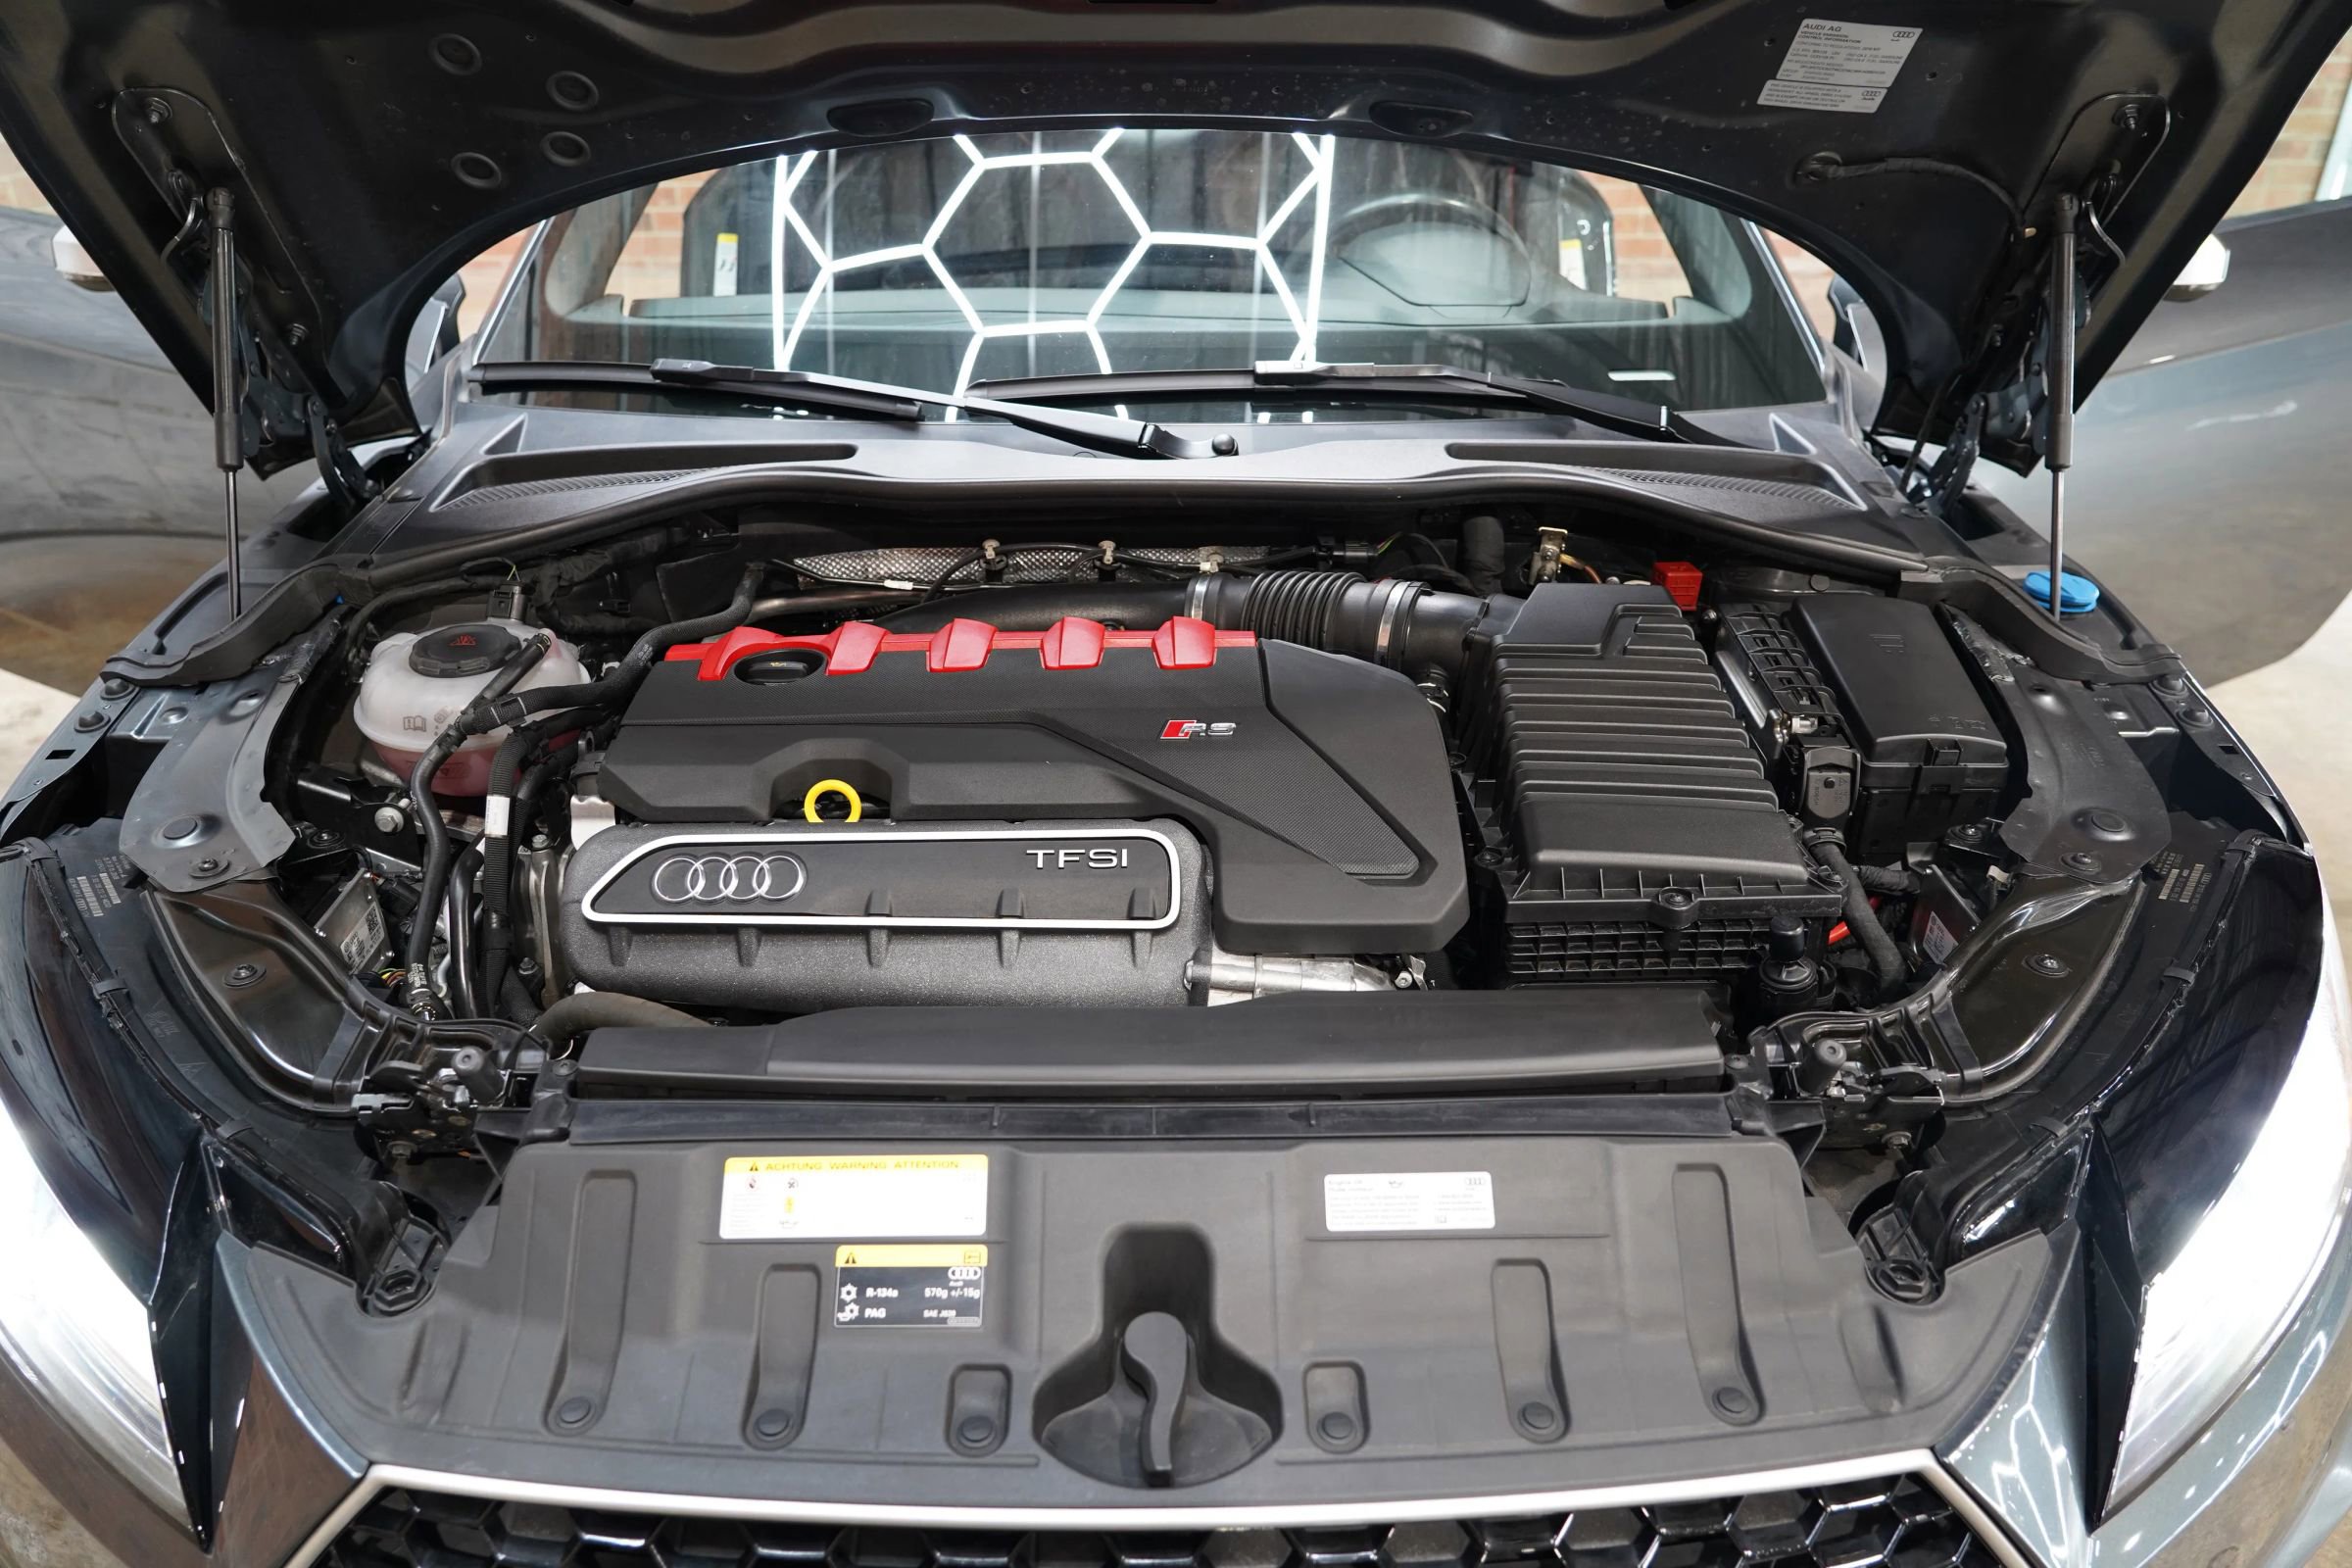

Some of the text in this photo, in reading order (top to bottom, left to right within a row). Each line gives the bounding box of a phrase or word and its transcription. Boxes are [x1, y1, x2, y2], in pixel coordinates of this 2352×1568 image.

[1171, 721, 1237, 737] RS
[1026, 849, 1128, 869] TFSI
[765, 1160, 959, 1171] ACHTUNG WARNING ATTENTION
[865, 1287, 899, 1298] R-134a
[924, 1287, 949, 1299] 570g
[864, 1307, 887, 1319] PAG
